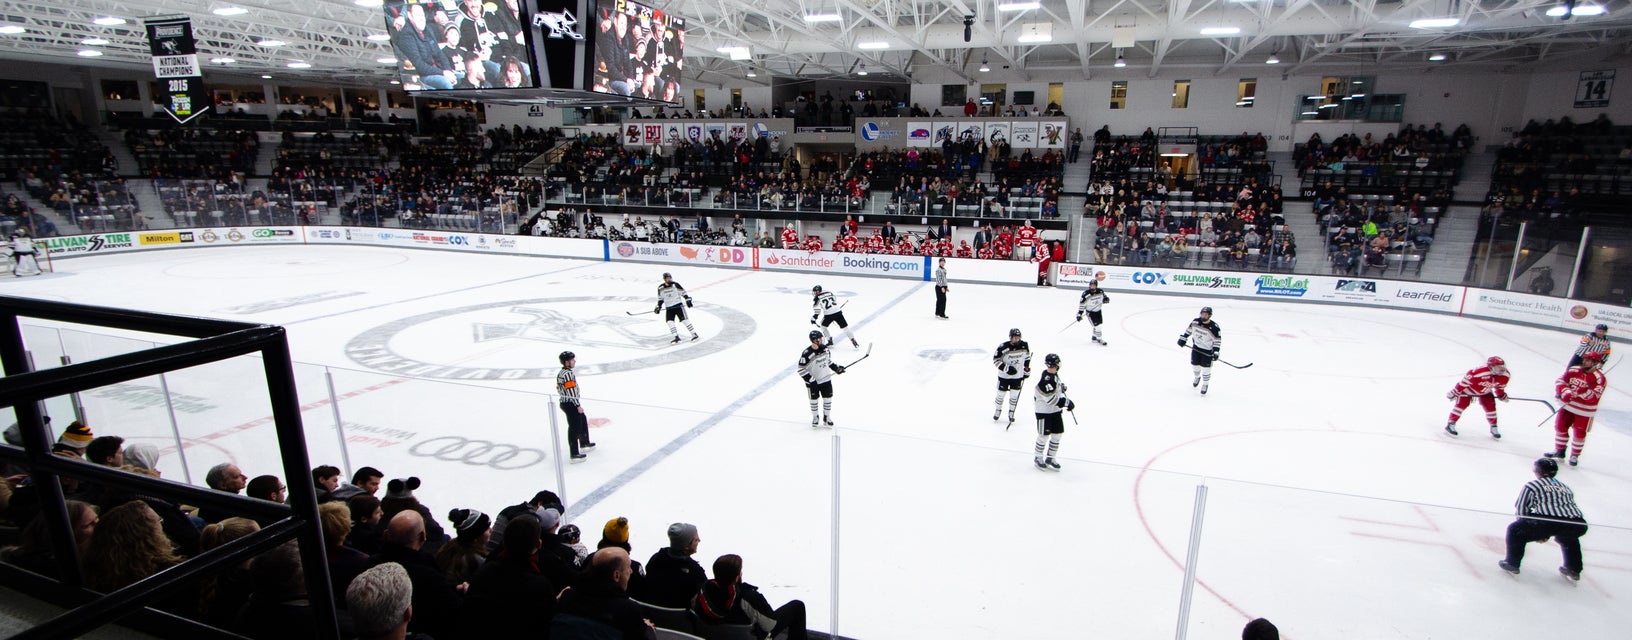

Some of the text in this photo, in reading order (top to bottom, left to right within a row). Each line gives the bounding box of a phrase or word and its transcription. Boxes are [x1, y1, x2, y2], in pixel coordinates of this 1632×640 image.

[160, 57, 189, 65] NATIONAL
[160, 66, 193, 76] CHAMPIONS
[169, 80, 189, 92] 2015
[1584, 81, 1607, 100] 14
[1304, 190, 1317, 198] 104
[105, 233, 131, 243] TIRE
[146, 235, 174, 243] Milton
[449, 235, 470, 246] COX
[651, 248, 669, 256] ABOVE
[781, 255, 835, 268] Santander
[843, 256, 919, 272] Booking.com
[1132, 271, 1169, 285] COX
[1173, 274, 1242, 285] SULLIVAN TIRE
[1396, 288, 1453, 303] Learfield
[1488, 296, 1533, 309] Southcoast
[1535, 302, 1562, 313] Health
[347, 435, 401, 448] Audi
